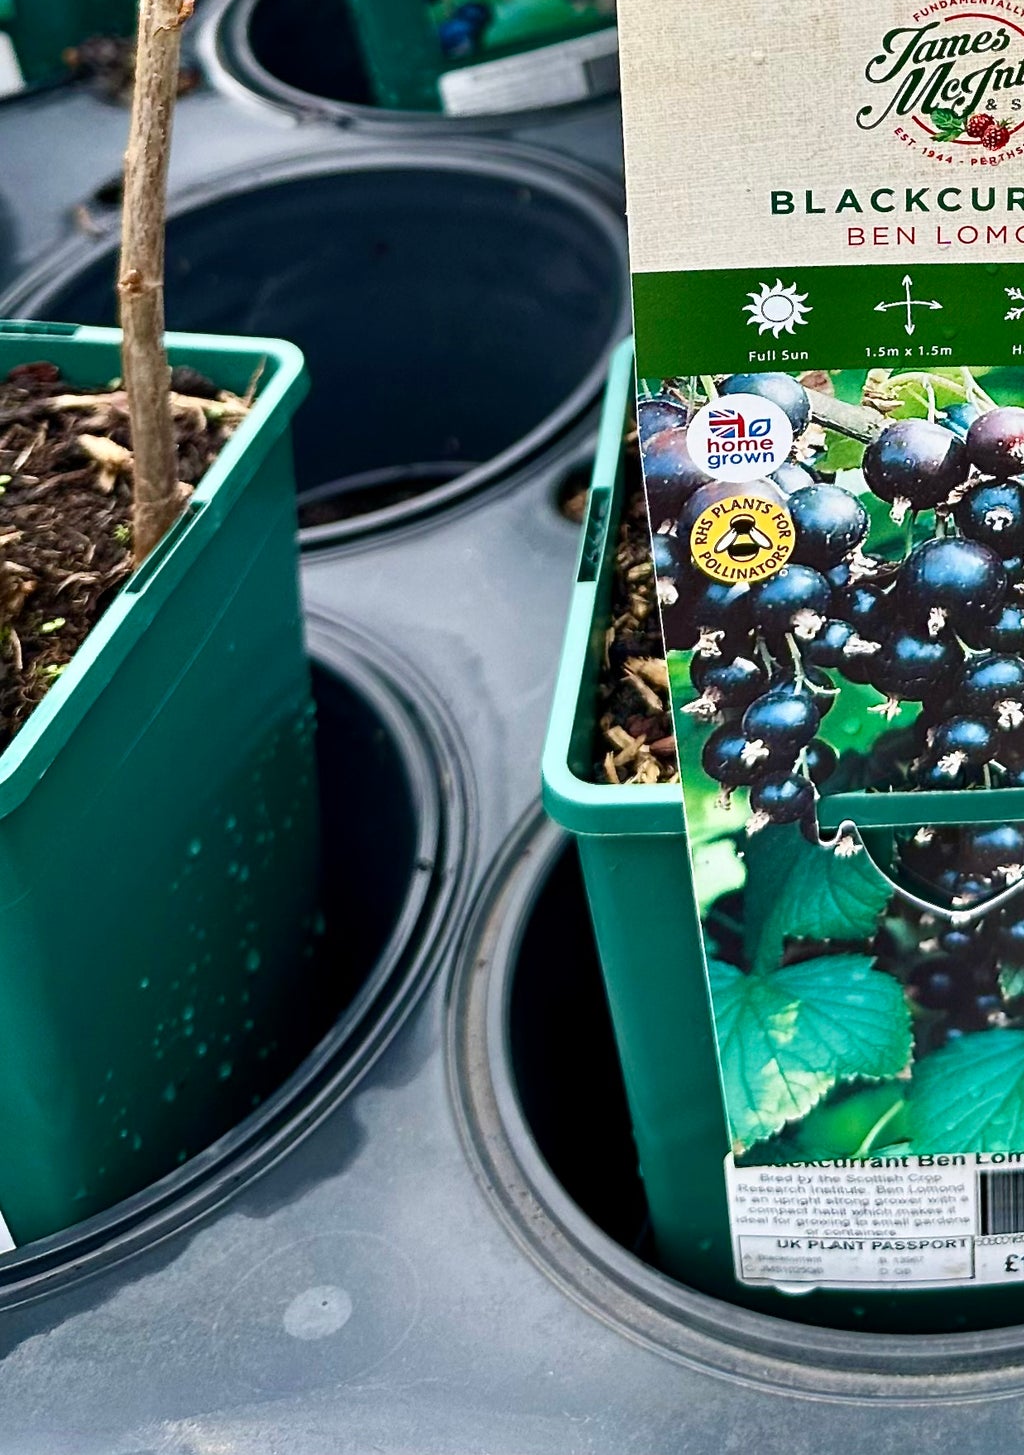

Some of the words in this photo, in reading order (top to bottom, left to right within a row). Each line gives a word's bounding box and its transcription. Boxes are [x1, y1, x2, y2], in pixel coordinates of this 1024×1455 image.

[865, 21, 1011, 84] James
[985, 98, 998, 111] &
[922, 147, 953, 164] 1944
[847, 226, 915, 245] BEN
[749, 350, 776, 362] Full
[782, 349, 809, 361] Sun
[865, 346, 899, 357] 1.5m
[904, 348, 912, 356] x
[918, 345, 953, 356] 1.5m
[707, 438, 774, 453] home
[707, 451, 775, 470] grown
[695, 518, 713, 546] RHS
[711, 497, 773, 518] PLANTS
[772, 512, 792, 539] FOR
[698, 544, 789, 580] POLLINATORS
[918, 1153, 966, 1167] Ben
[760, 1173, 793, 1182] Bred
[798, 1174, 813, 1184] by
[819, 1174, 841, 1182] the
[846, 1173, 903, 1183] Scottish
[907, 1173, 942, 1184] Crop
[738, 1183, 806, 1194] Research
[876, 1185, 904, 1193] Ben
[773, 1196, 821, 1206] upright
[825, 1196, 869, 1206] strong
[874, 1197, 922, 1206] grower
[927, 1195, 957, 1203] with
[748, 1207, 808, 1216] compact
[813, 1206, 847, 1215] habit
[852, 1206, 892, 1215] which
[773, 1216, 790, 1224] for
[796, 1217, 850, 1227] growing
[871, 1217, 910, 1226] small
[823, 1228, 897, 1237] containers
[776, 1239, 801, 1249] UK
[808, 1240, 866, 1250] PLANT
[872, 1238, 967, 1250] PASSPORT
